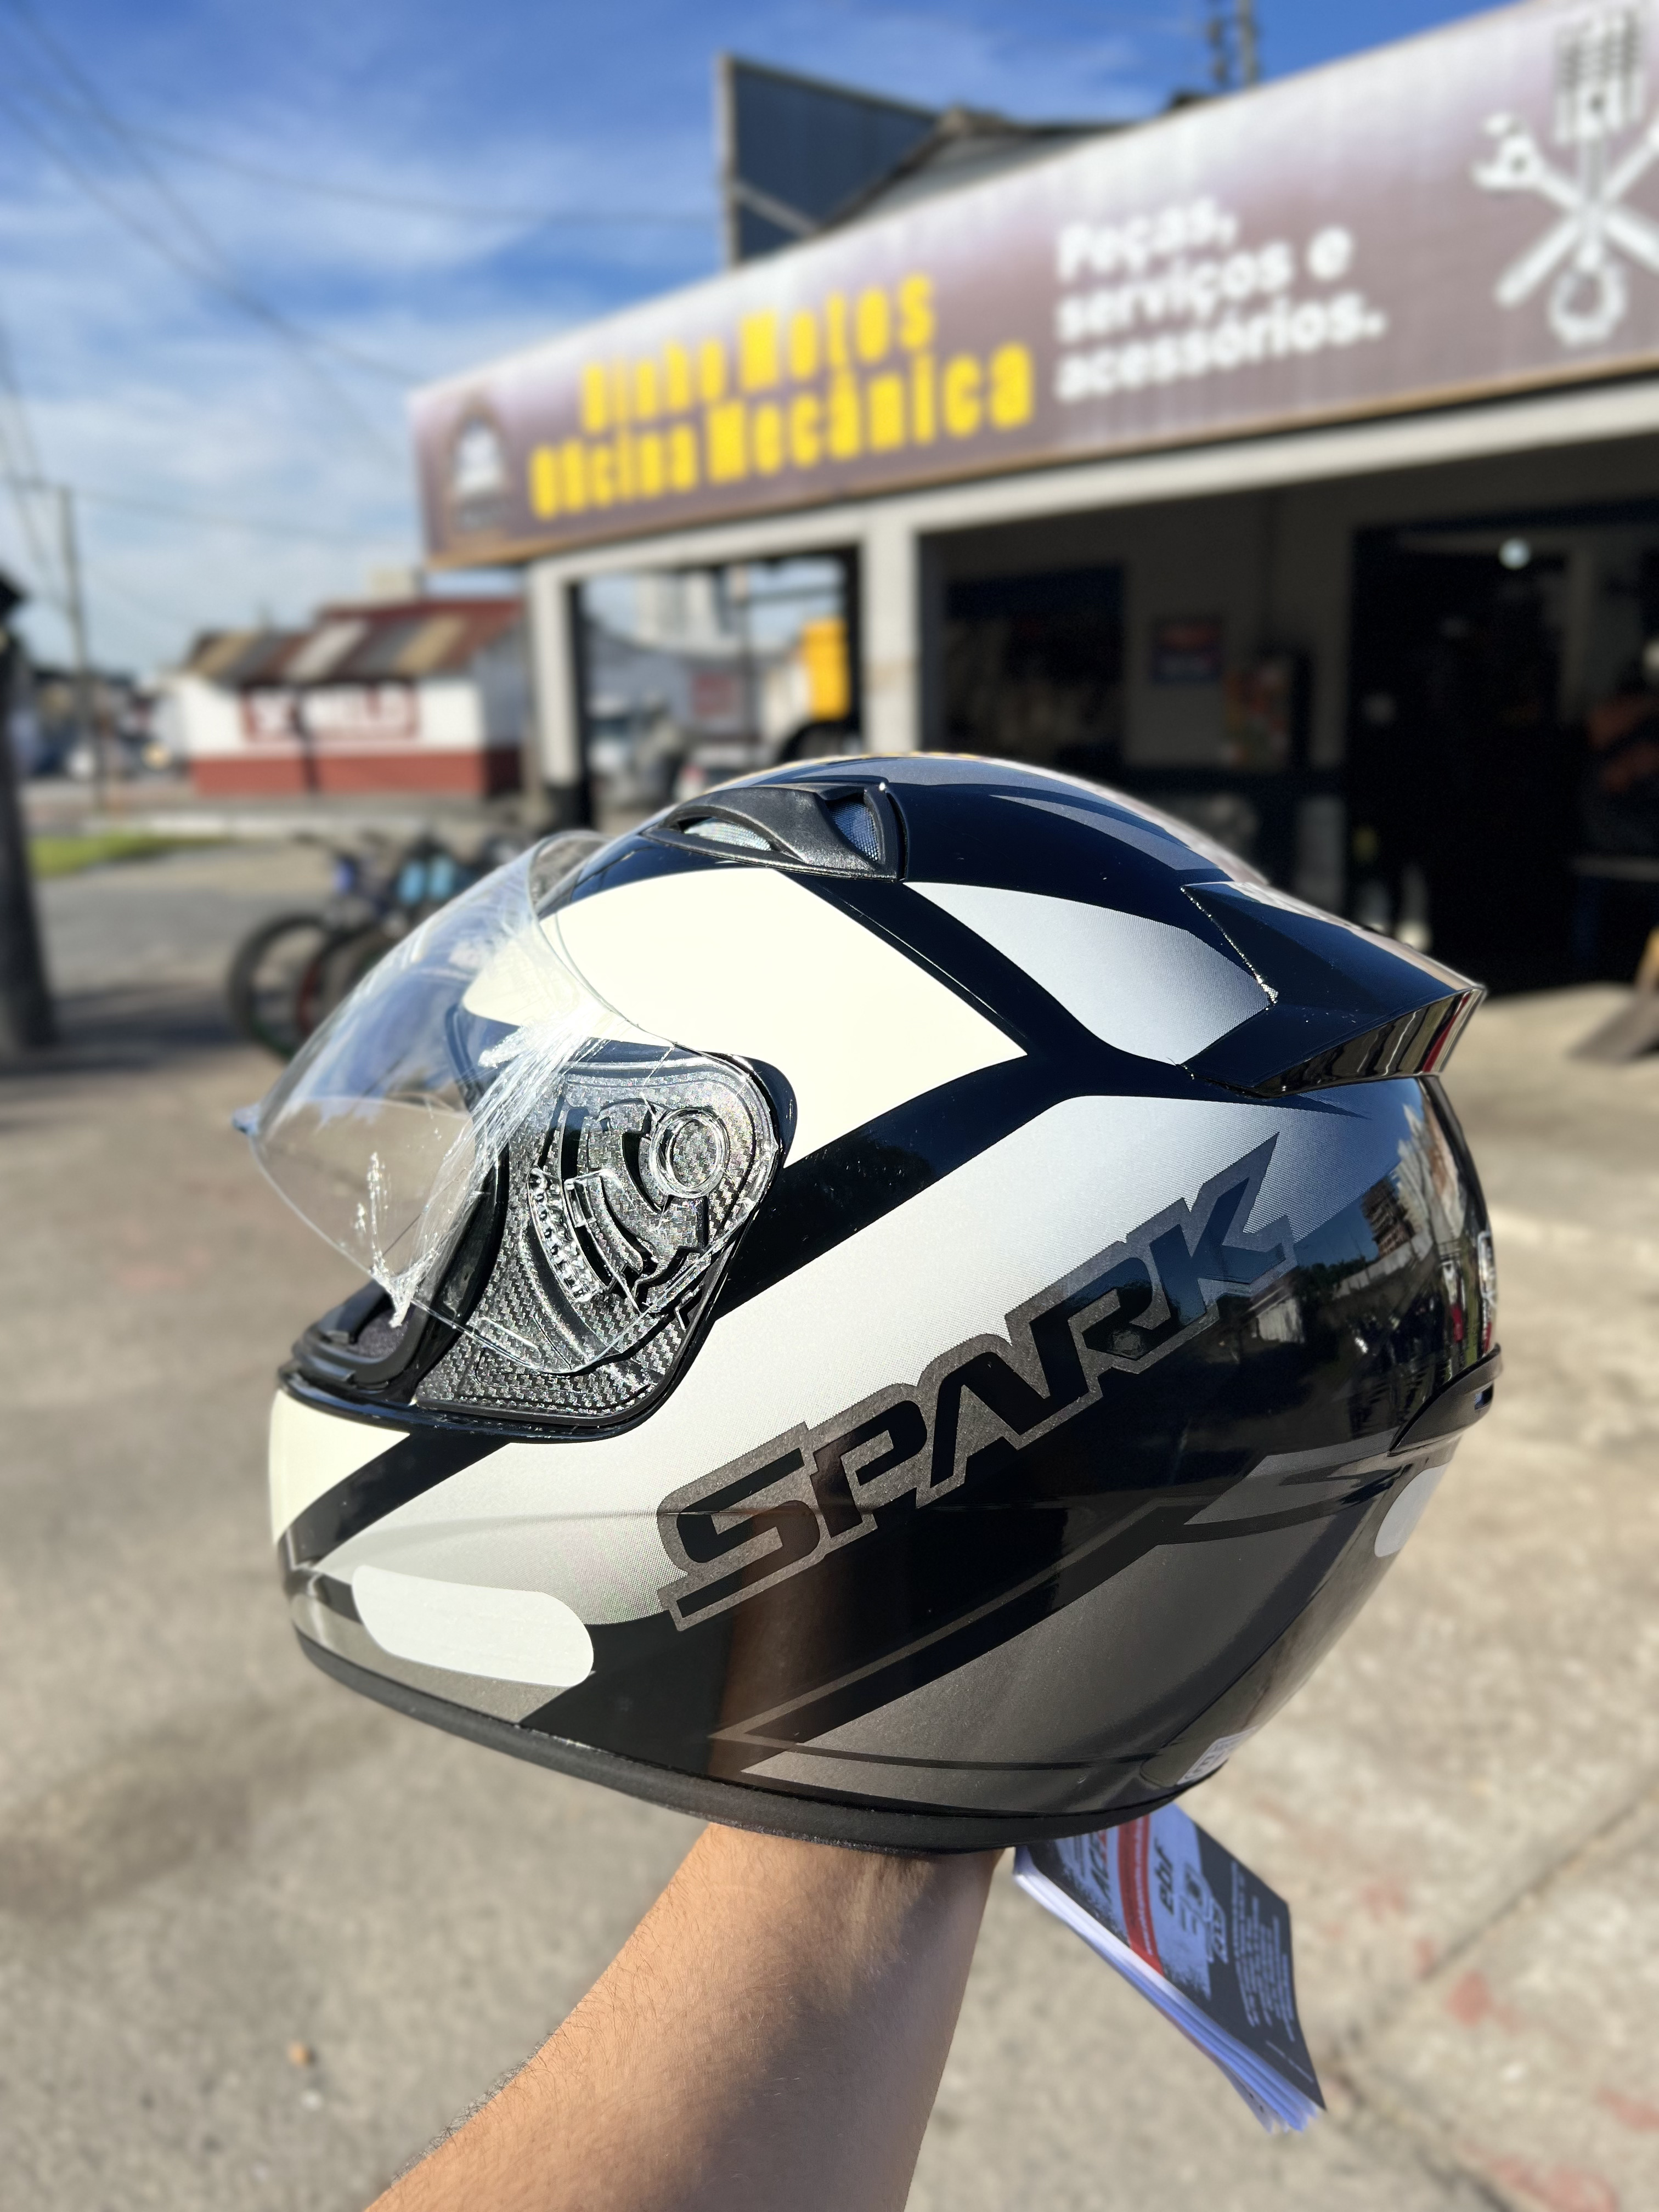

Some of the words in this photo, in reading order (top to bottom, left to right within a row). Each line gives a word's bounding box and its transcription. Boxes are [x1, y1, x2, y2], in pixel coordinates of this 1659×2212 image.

[738, 273, 934, 394] Motos
[1057, 241, 1291, 343] serviços
[1308, 225, 1353, 280] e
[1054, 291, 1387, 404] acessórios.
[707, 341, 1033, 484] Mecânica
[658, 1132, 1300, 1631] SPARK
